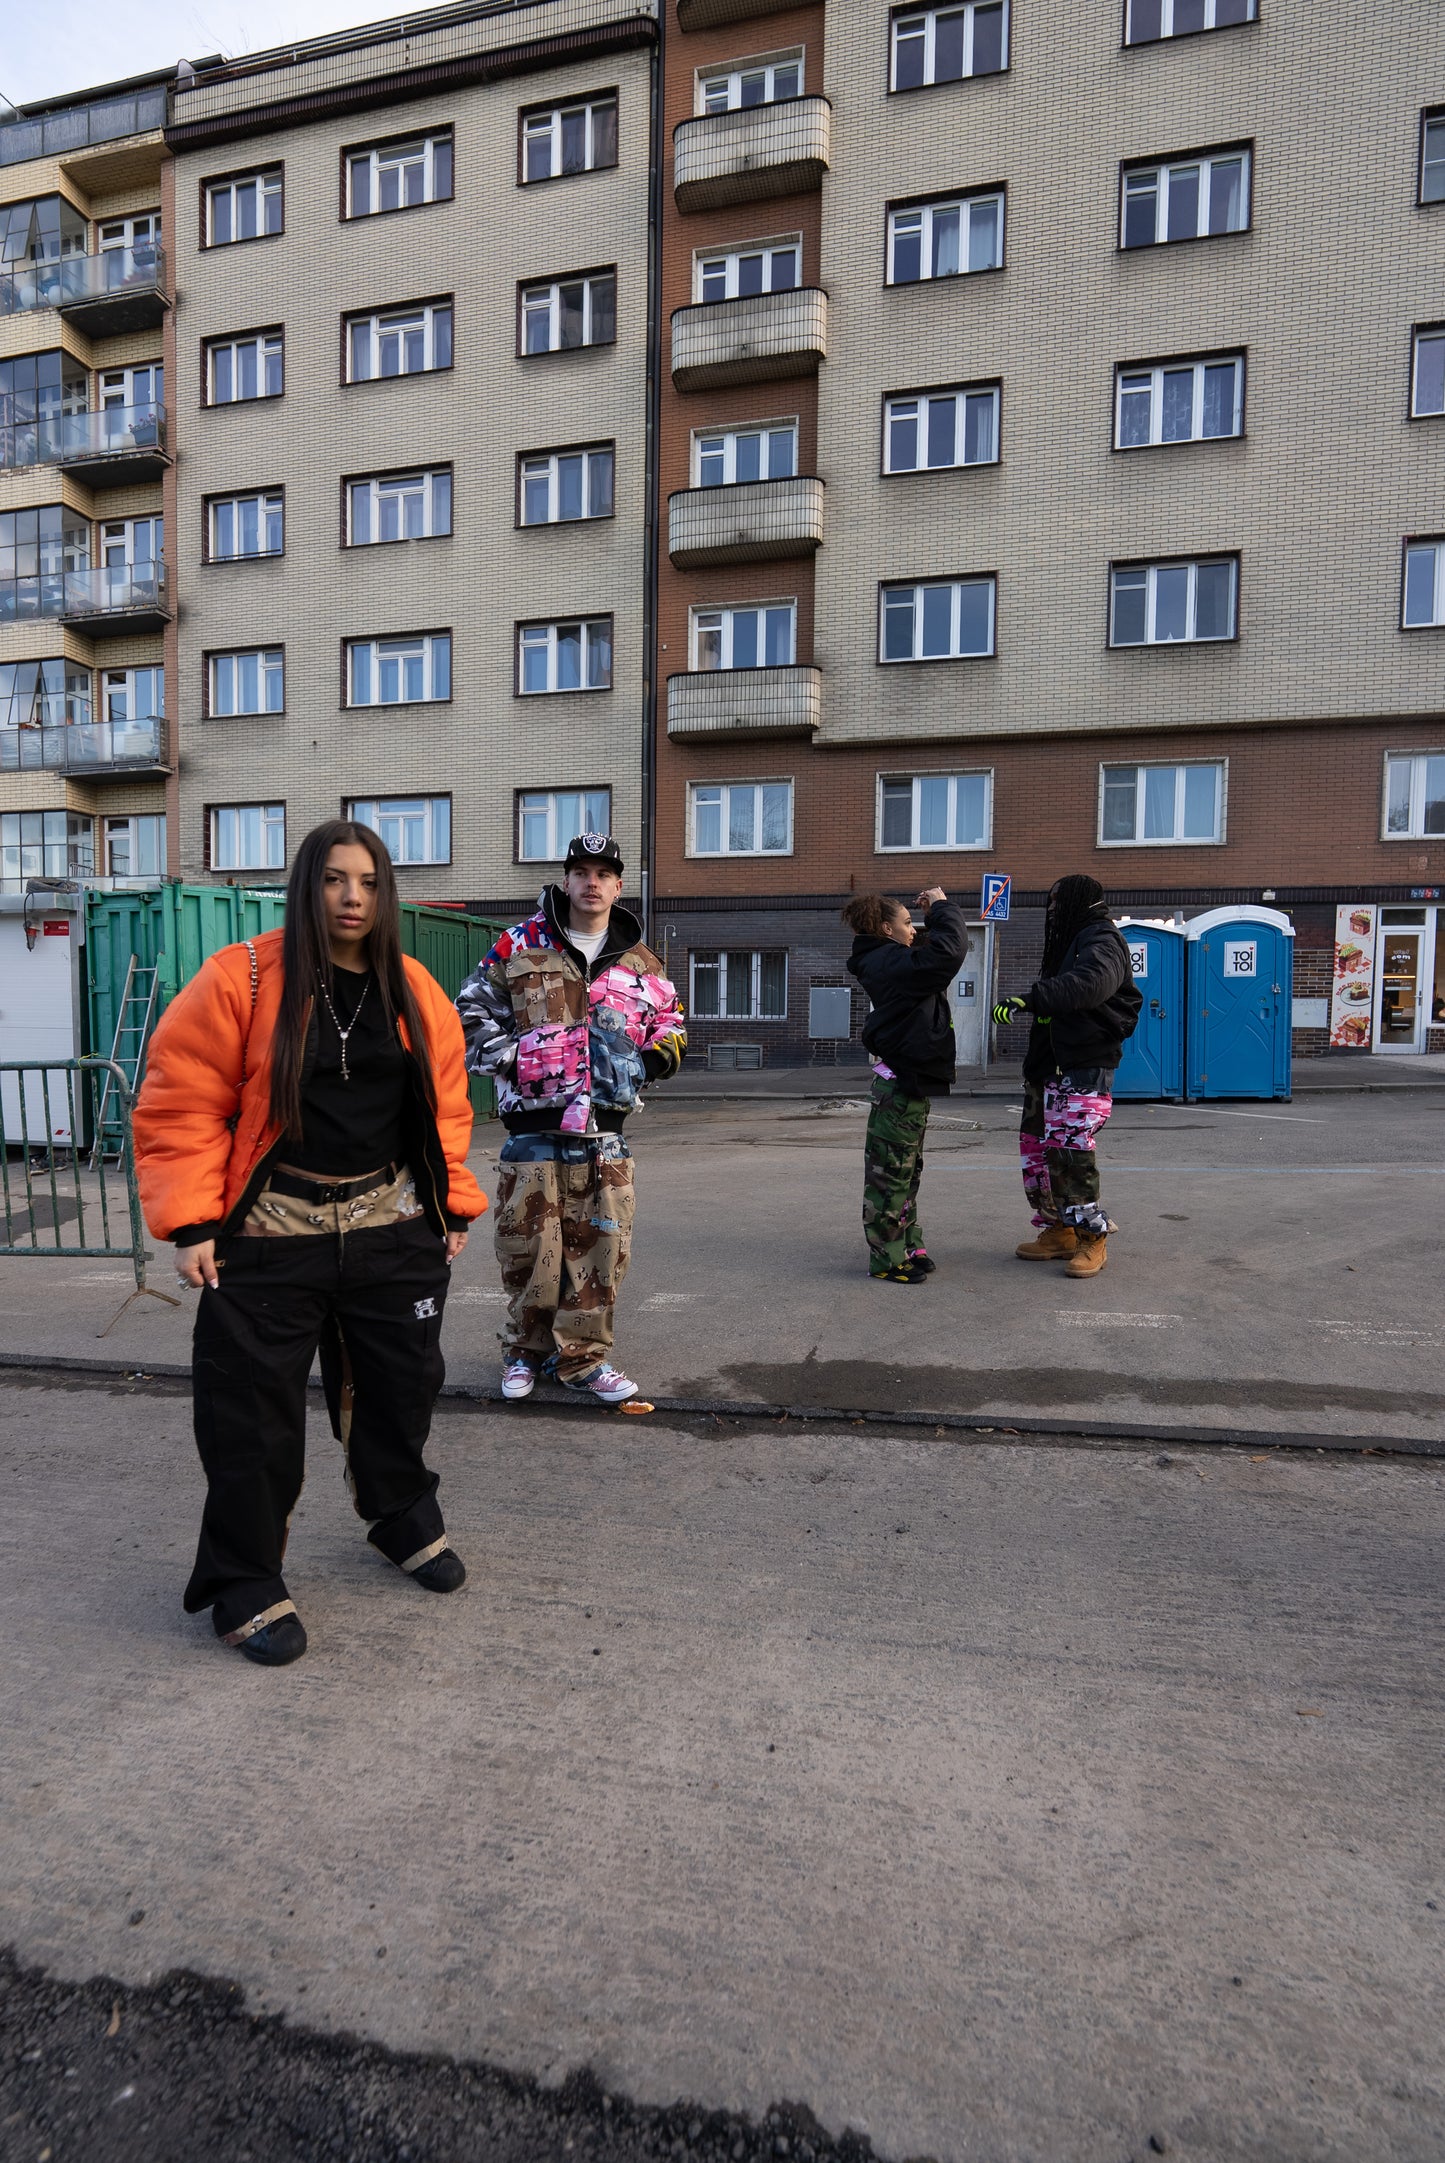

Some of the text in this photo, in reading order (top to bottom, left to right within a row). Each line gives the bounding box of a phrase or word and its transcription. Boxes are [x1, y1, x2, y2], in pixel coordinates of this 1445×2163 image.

[988, 879, 1005, 905] P
[1129, 952, 1144, 962] OI
[1233, 950, 1253, 961] TOI
[1131, 962, 1144, 973] OI
[1233, 961, 1253, 972] TOI
